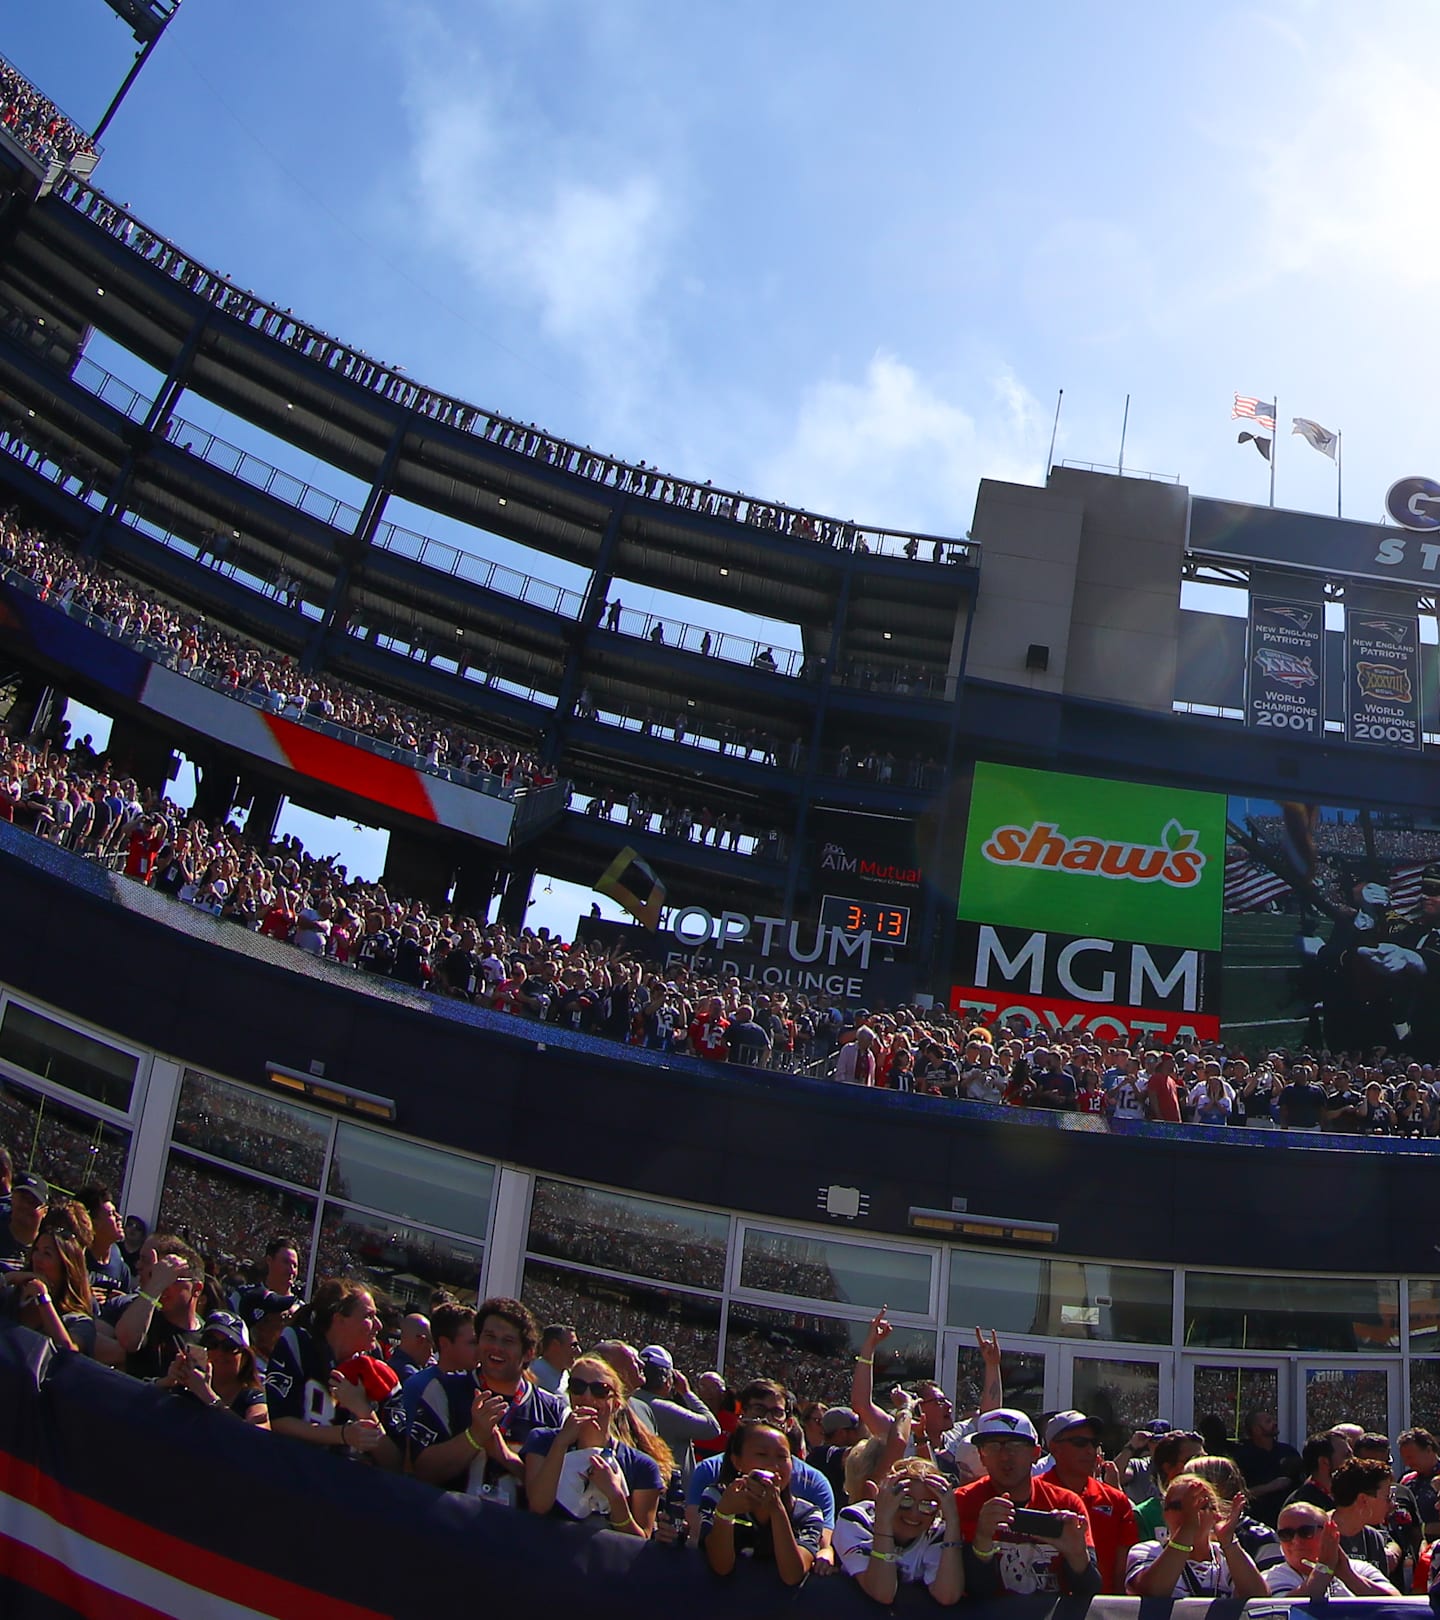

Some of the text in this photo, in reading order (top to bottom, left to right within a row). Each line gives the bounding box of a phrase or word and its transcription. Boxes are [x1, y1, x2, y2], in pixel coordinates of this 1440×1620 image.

[1256, 711, 1314, 731] 2001
[1354, 723, 1415, 744] 2003
[822, 854, 922, 882] AIM Mutual
[846, 906, 901, 936] 3:13
[674, 906, 872, 970] OPTUM
[974, 925, 1199, 1011] MGM
[1089, 1097, 1101, 1112] 12
[1119, 1090, 1138, 1110] 12
